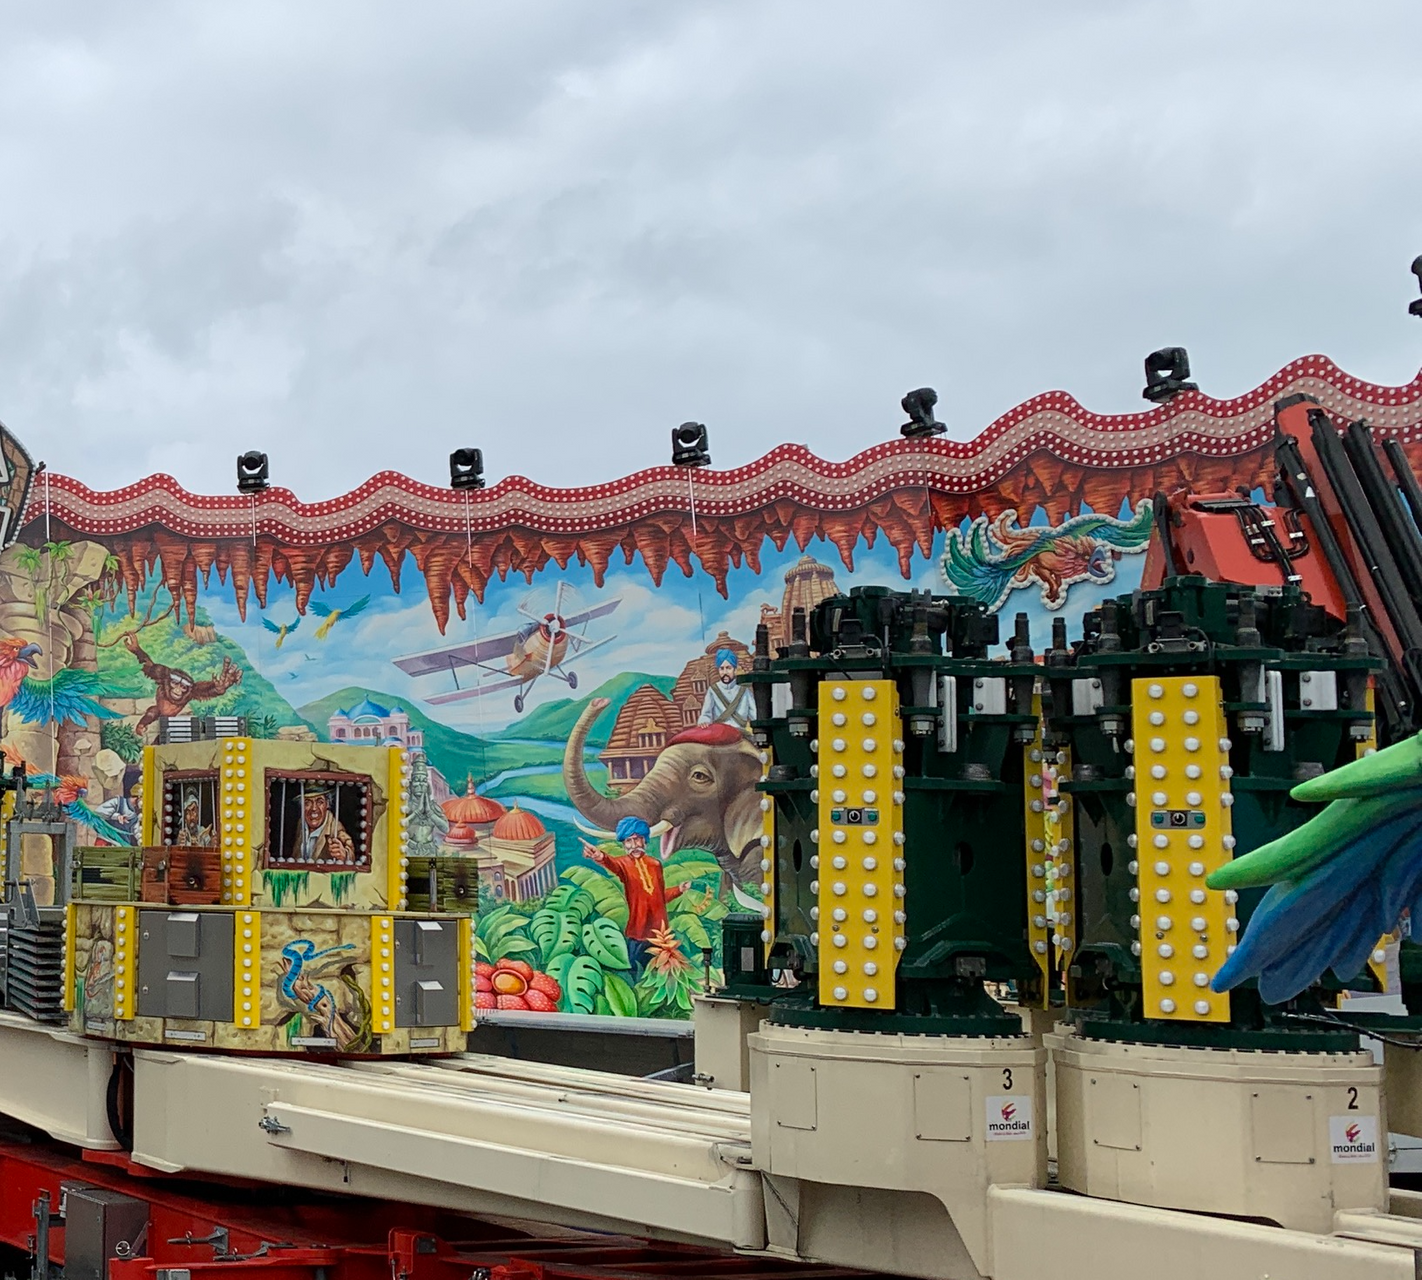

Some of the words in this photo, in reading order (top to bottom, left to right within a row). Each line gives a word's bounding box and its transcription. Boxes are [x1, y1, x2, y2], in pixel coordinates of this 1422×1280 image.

[1002, 1068, 1013, 1090] 3
[1347, 1087, 1359, 1109] 2
[989, 1120, 1030, 1131] mondial
[1333, 1142, 1375, 1153] mondial
